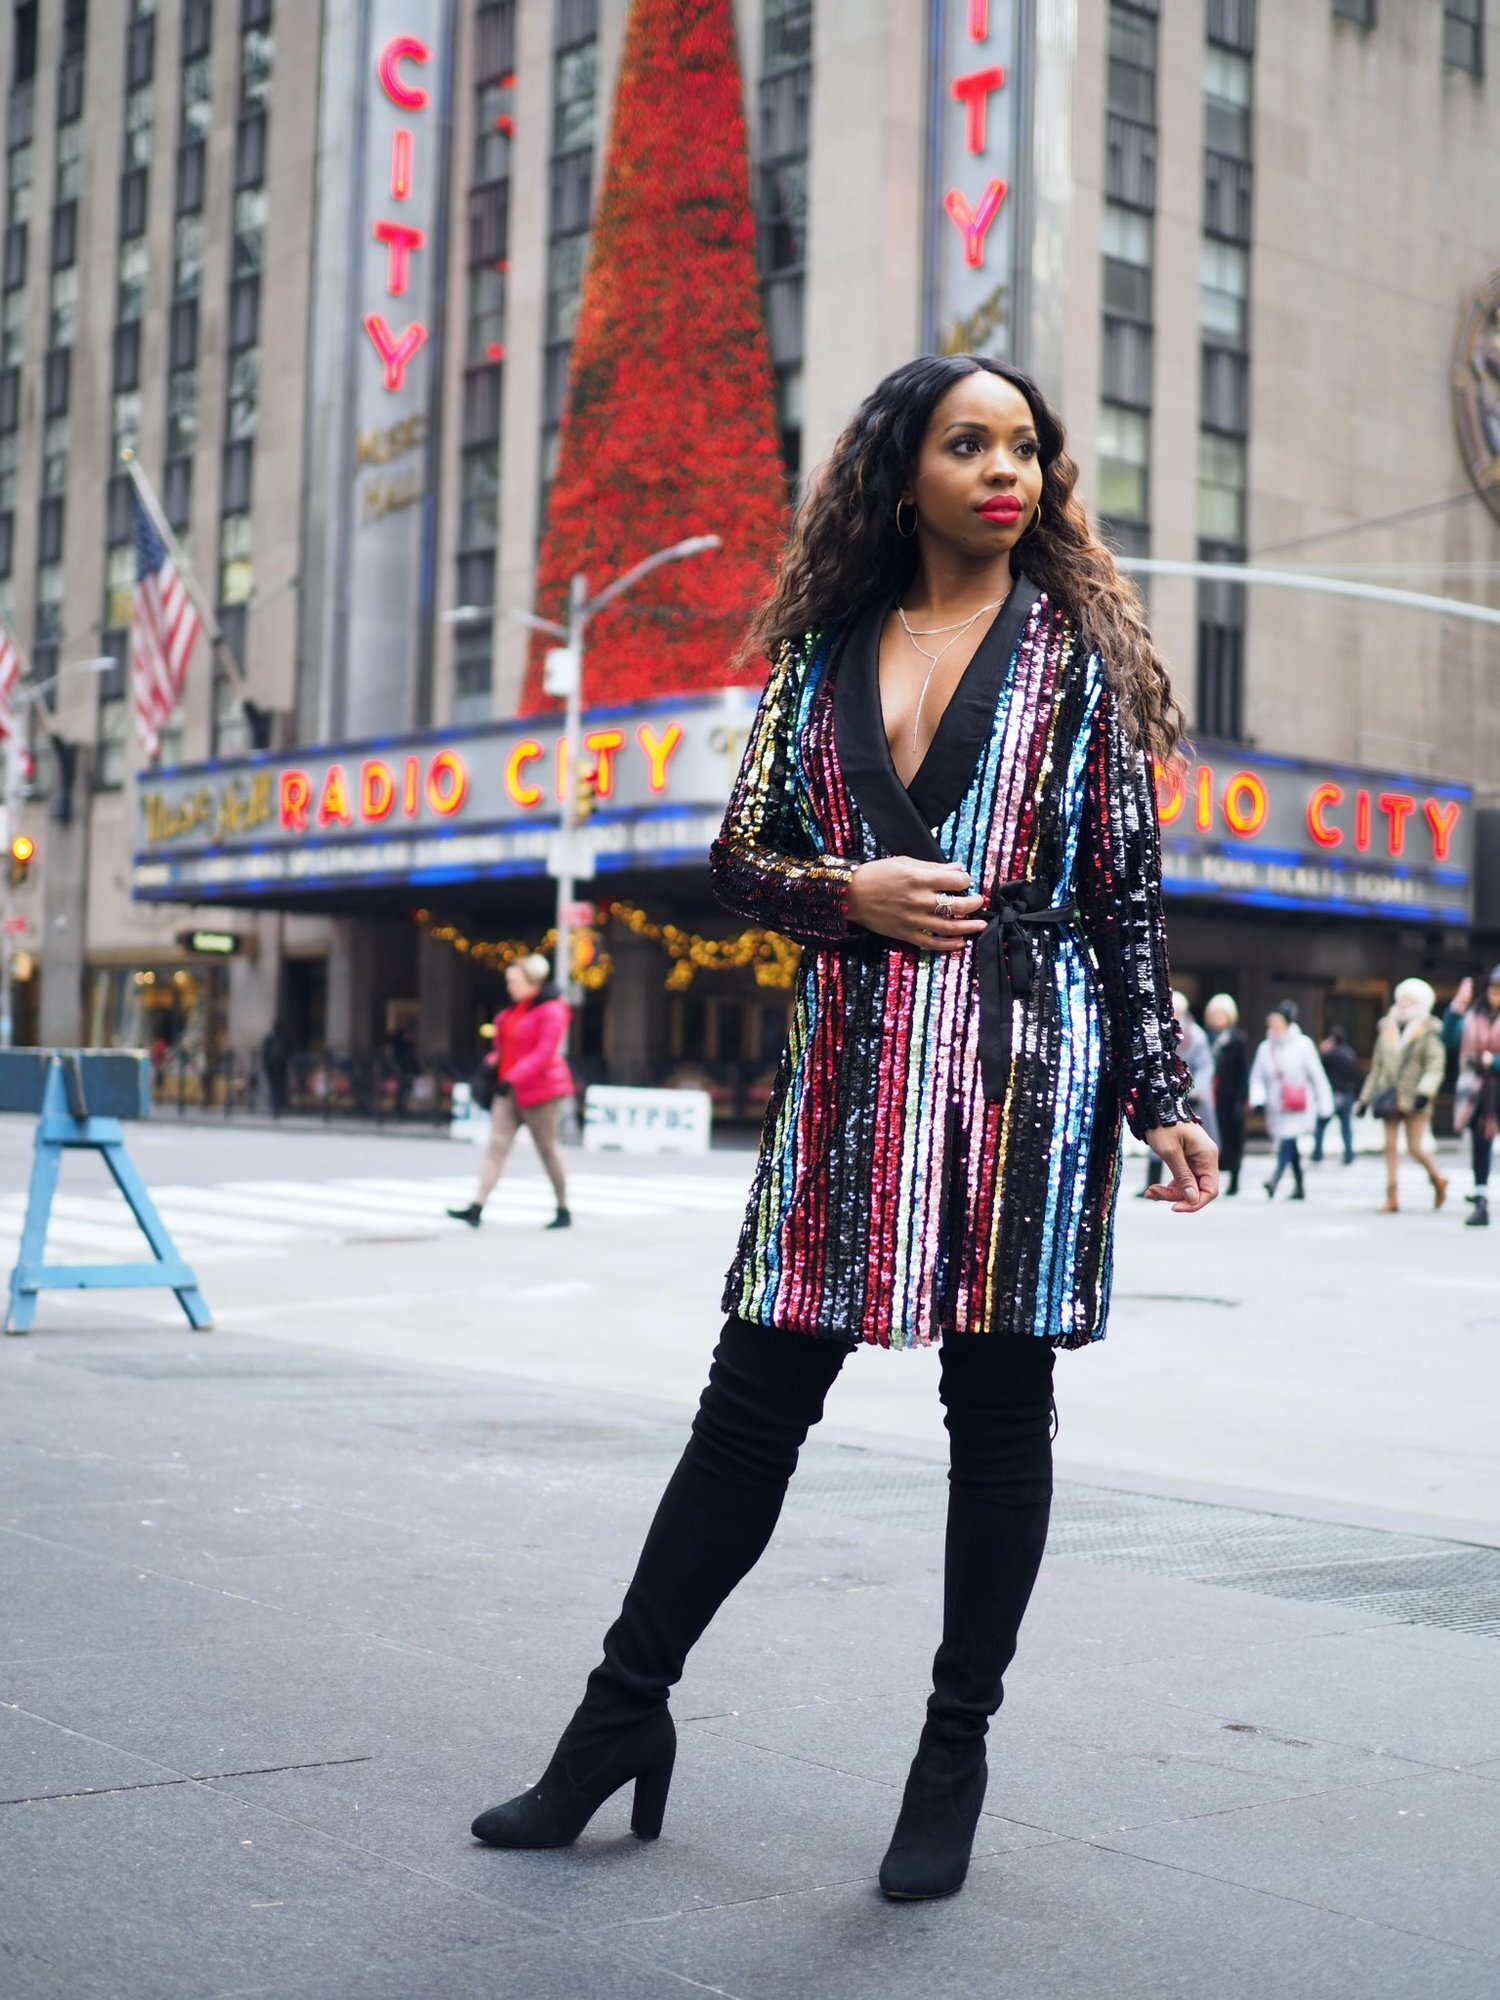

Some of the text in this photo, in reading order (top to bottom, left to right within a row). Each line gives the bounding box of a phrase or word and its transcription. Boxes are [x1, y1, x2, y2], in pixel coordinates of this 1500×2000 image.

[364, 35, 431, 392] CITY
[279, 749, 467, 832] RADIO
[504, 719, 685, 809] CITY
[1153, 755, 1461, 862] DIO CITY
